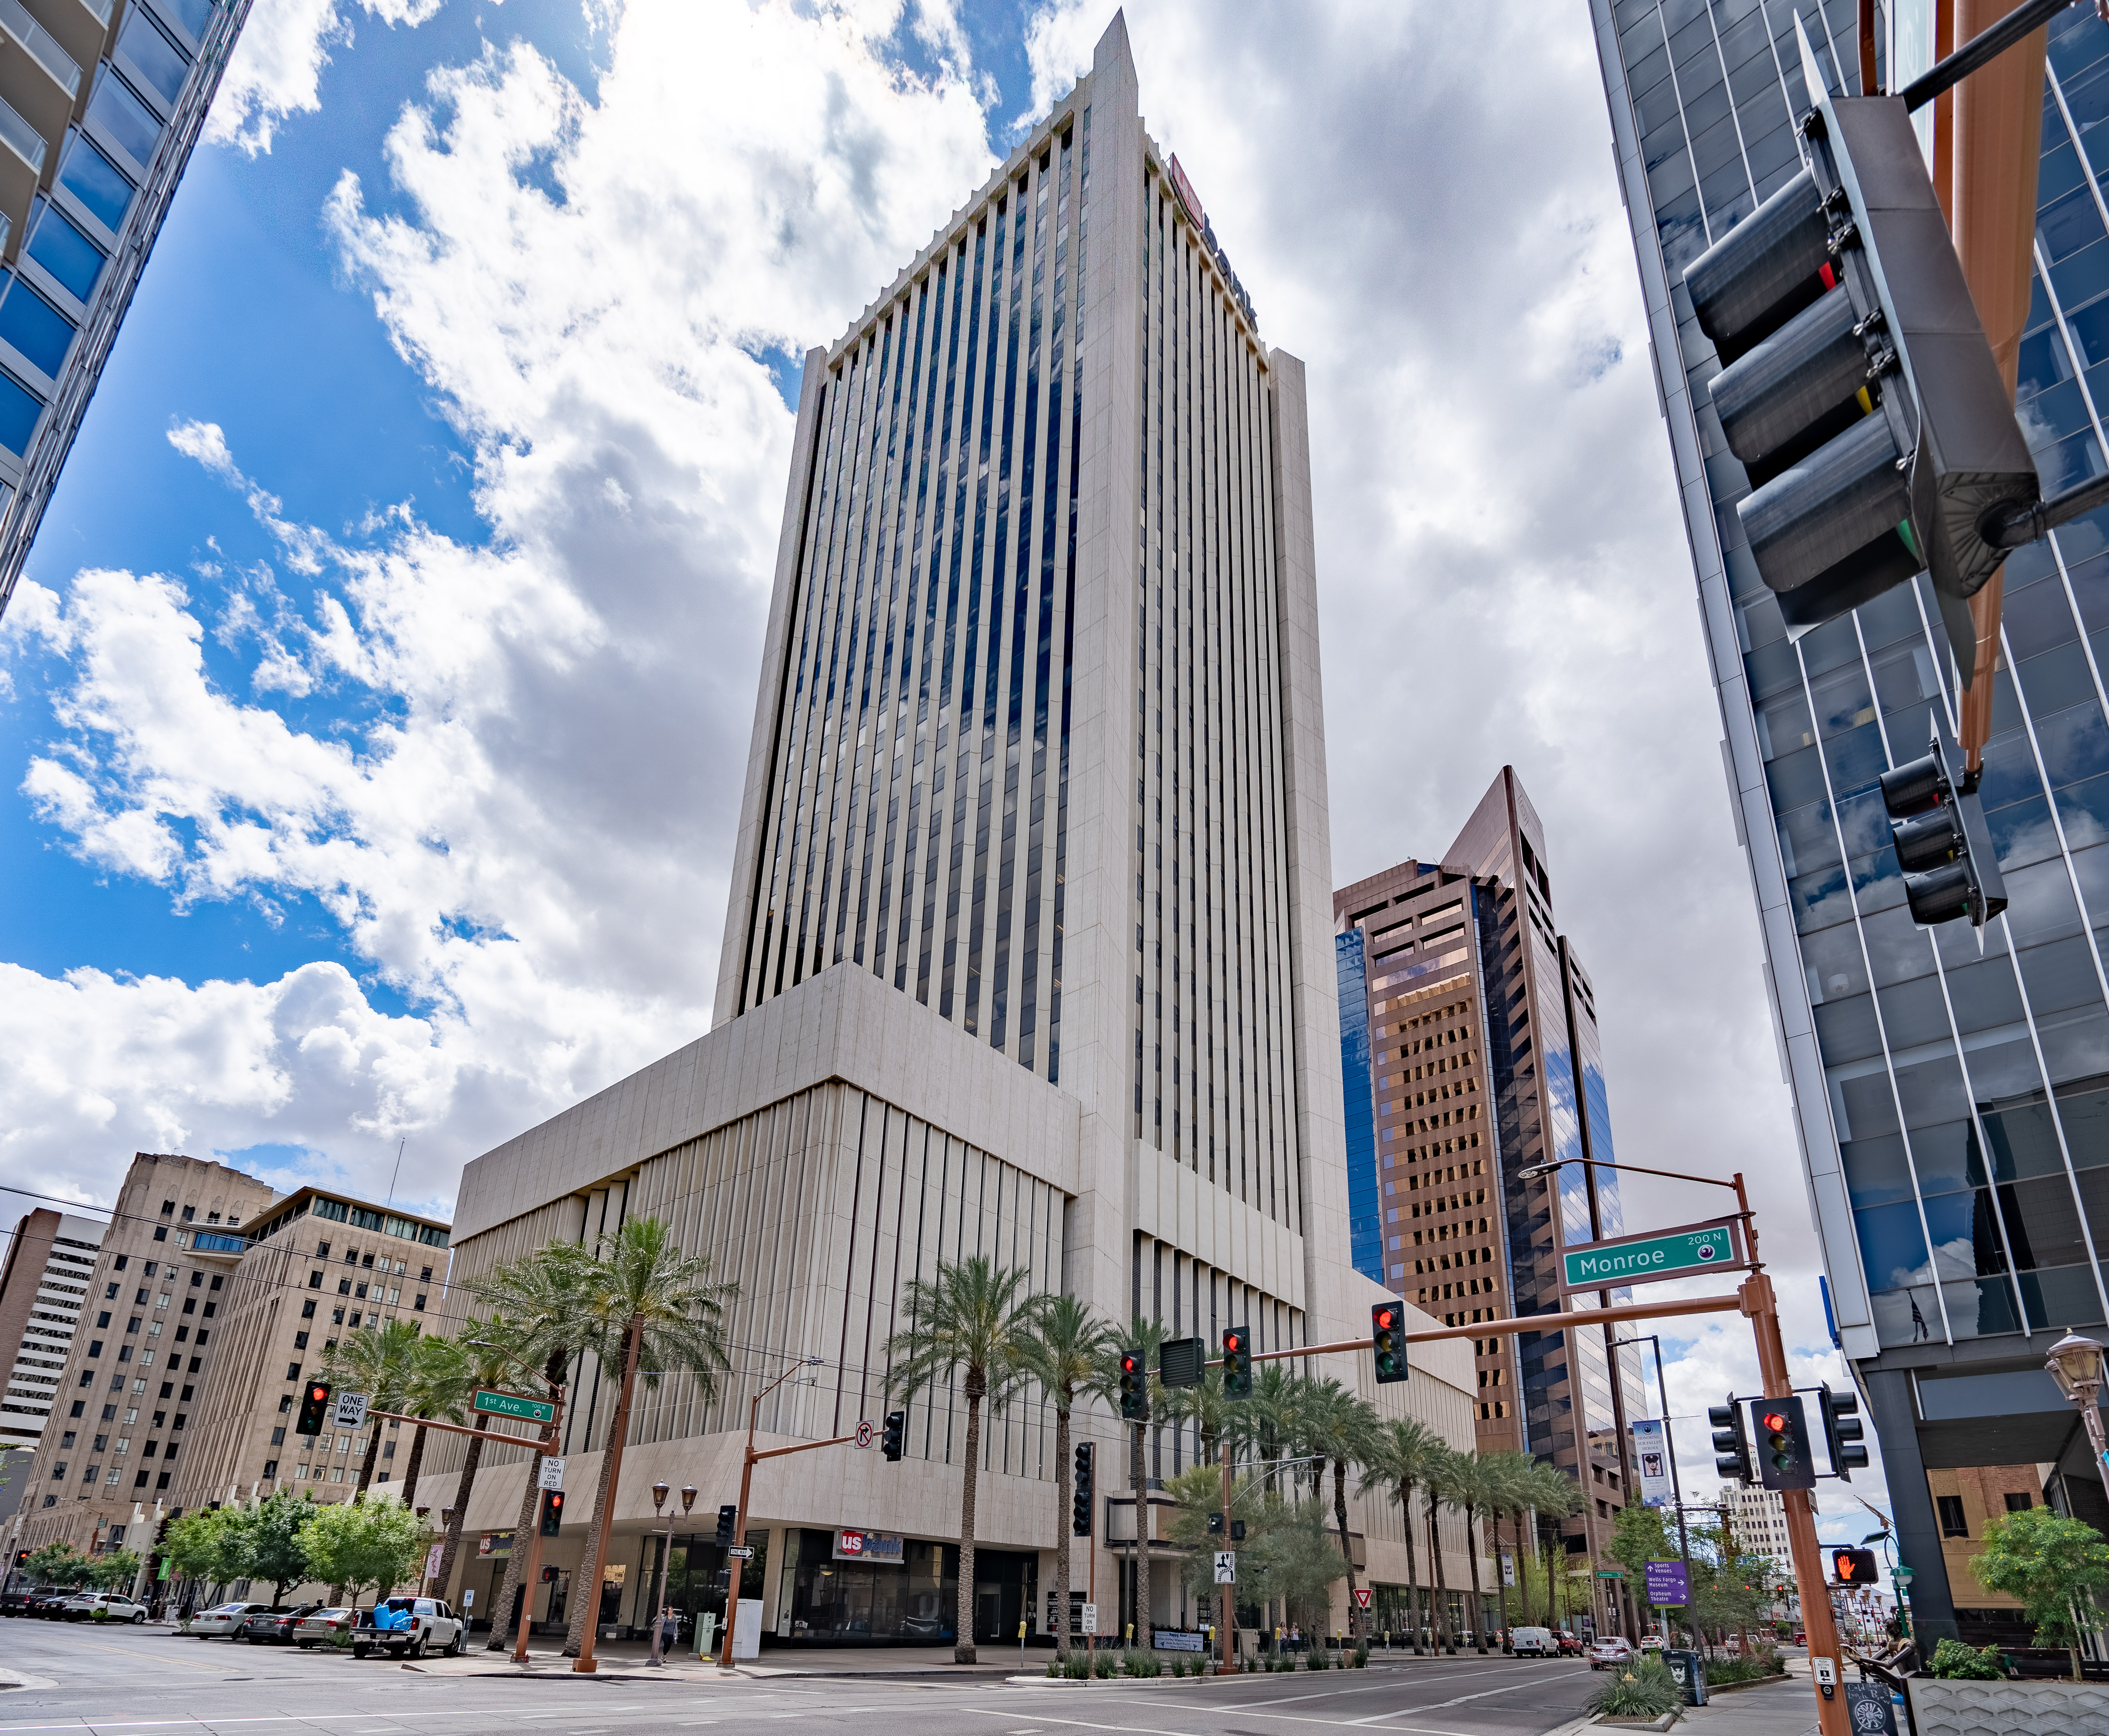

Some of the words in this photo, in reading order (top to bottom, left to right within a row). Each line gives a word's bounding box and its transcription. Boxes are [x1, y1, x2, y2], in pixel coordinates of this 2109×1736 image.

[1688, 1234, 1710, 1245] 200
[1713, 1232, 1722, 1241] N
[1580, 1250, 1665, 1275] Monroe
[342, 1395, 364, 1406] ONE
[484, 1397, 497, 1406] 1st
[499, 1400, 522, 1412] Ave.
[340, 1404, 363, 1415] WAY
[480, 1538, 491, 1550] us
[842, 1536, 861, 1550] us
[863, 1534, 902, 1553] bank
[1869, 1689, 1890, 1704] Brew
[1857, 1702, 1876, 1724] HIDDEN
